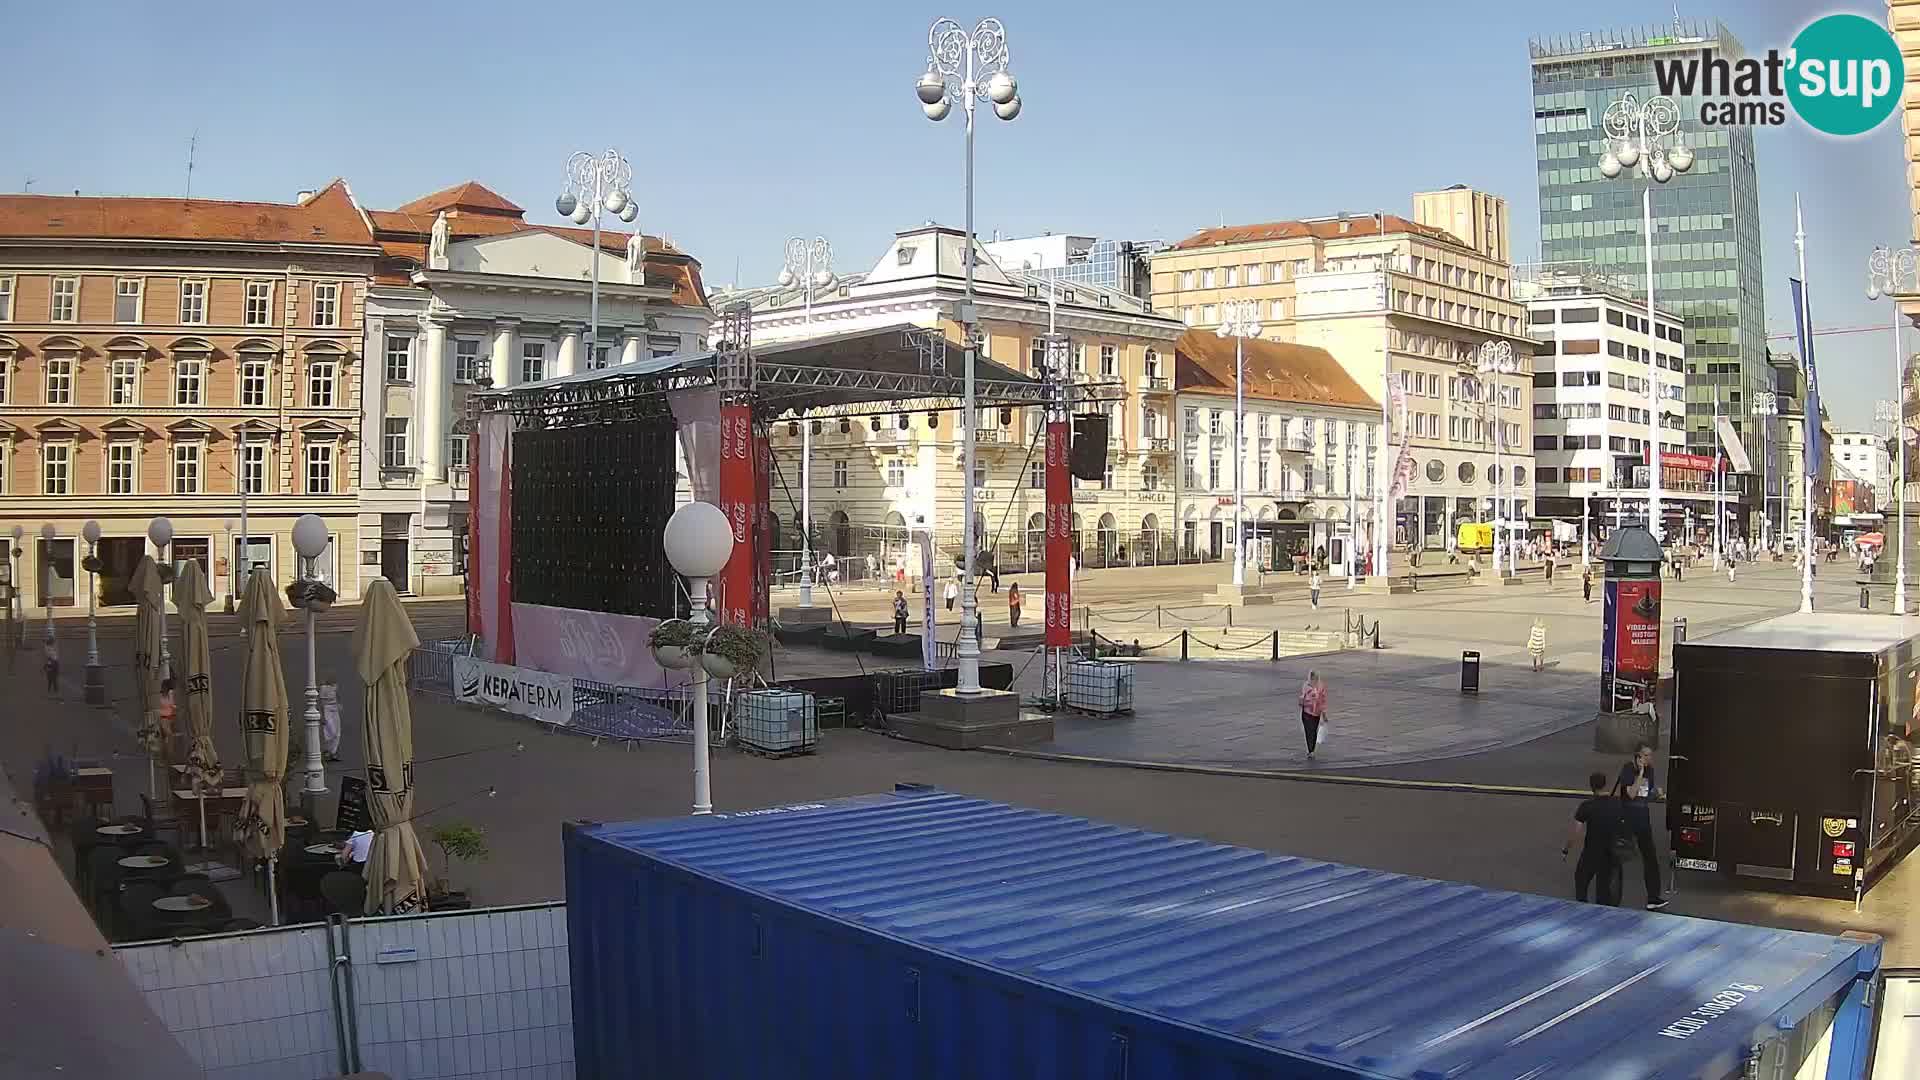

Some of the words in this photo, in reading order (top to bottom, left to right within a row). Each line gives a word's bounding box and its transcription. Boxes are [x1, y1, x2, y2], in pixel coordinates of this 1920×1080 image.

[1138, 493, 1166, 502] SINGER
[483, 675, 562, 710] KERATERM
[1691, 990, 1747, 1019] 300629
